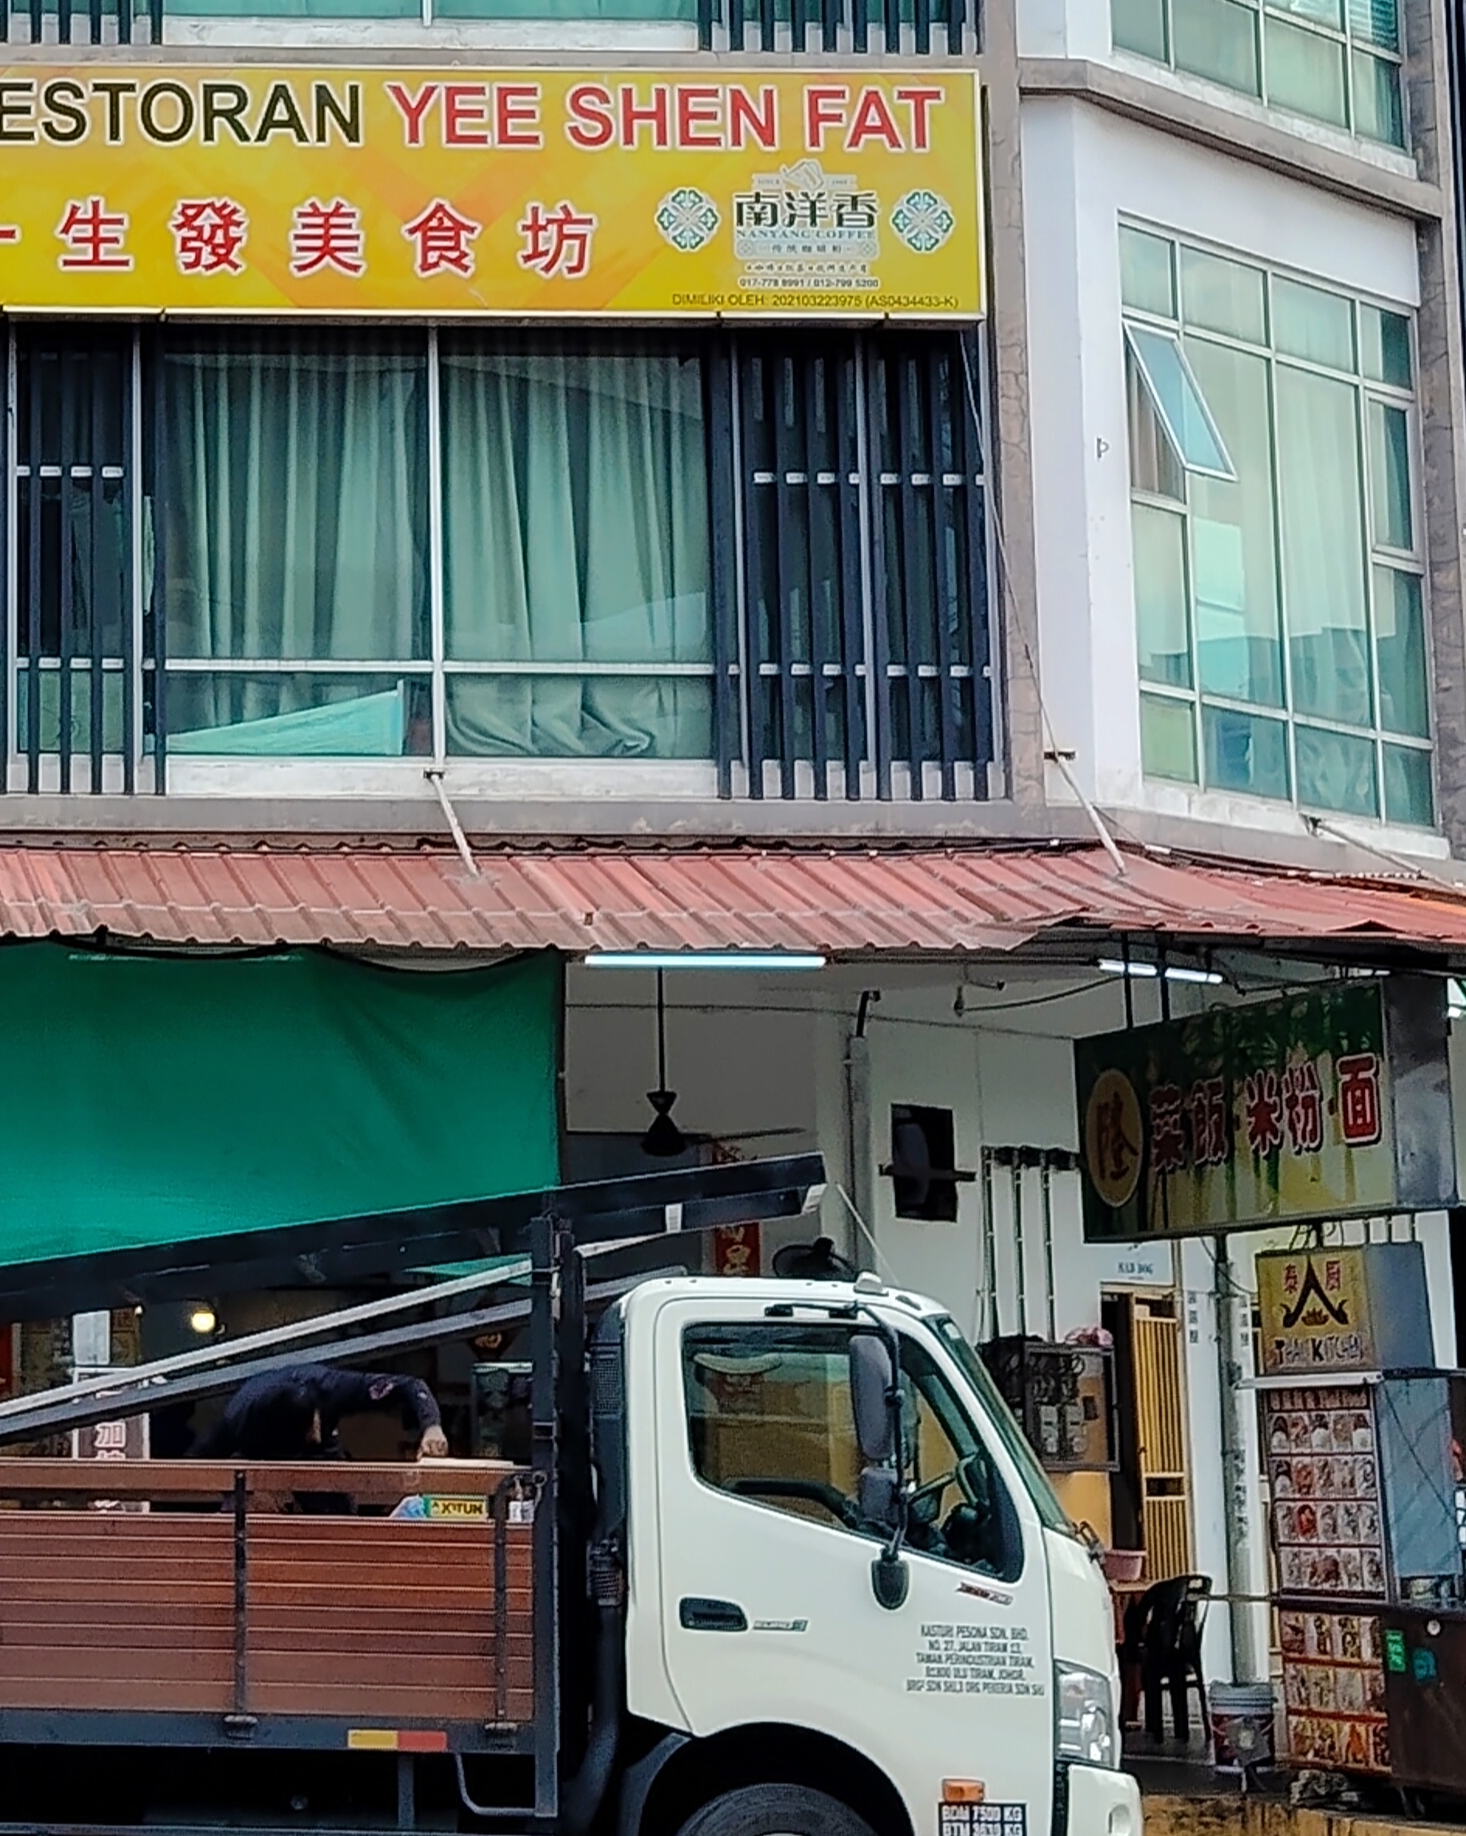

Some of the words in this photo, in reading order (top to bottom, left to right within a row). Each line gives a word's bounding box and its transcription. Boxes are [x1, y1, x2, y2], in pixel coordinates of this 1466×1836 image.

[386, 84, 541, 145] YEE
[567, 86, 777, 148] SHEN
[805, 88, 942, 149] FAT
[734, 191, 878, 228] 南洋香
[736, 229, 811, 239] NANYANG
[815, 230, 875, 240] COFFEE
[1003, 1806, 1024, 1822] KG
[1003, 1823, 1024, 1836] KG
